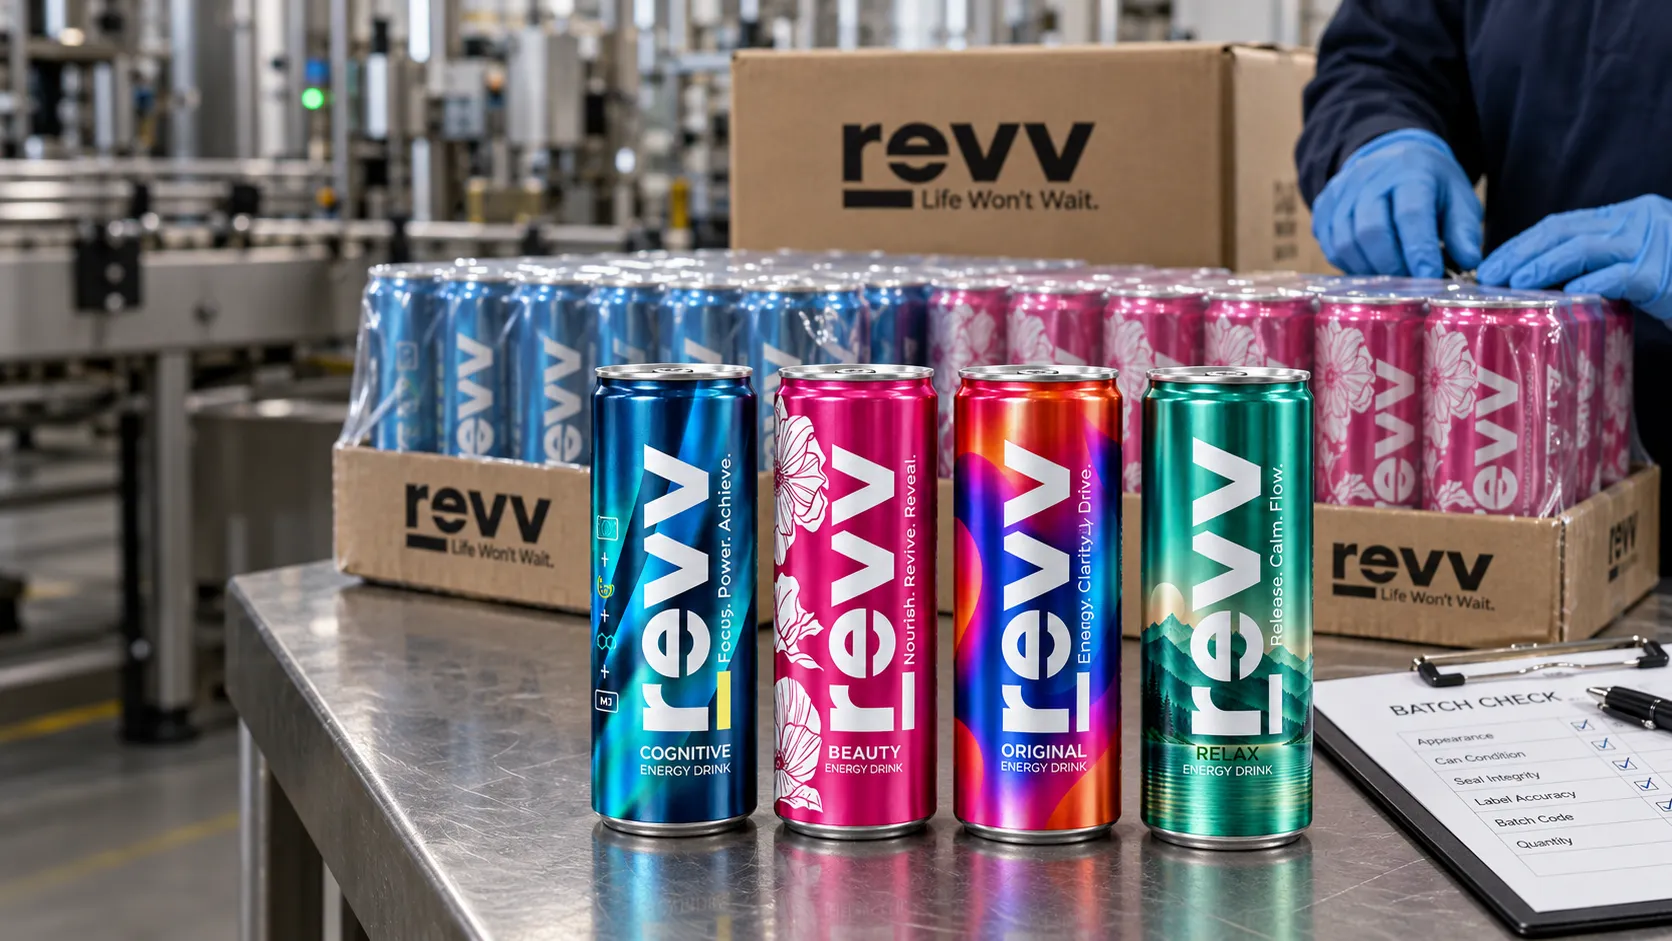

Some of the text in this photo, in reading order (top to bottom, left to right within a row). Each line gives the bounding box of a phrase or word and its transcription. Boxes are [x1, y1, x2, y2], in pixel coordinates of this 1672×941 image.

[842, 121, 1096, 185] revv
[922, 188, 1099, 210] Life Won't Wait.
[456, 332, 494, 455] evv
[543, 335, 583, 463] evv
[1373, 358, 1416, 508] evv
[1472, 365, 1519, 513] evv
[717, 453, 732, 532] Achieve.
[1077, 464, 1092, 513] Drive.
[405, 482, 552, 544] revv
[451, 538, 555, 568] Life Won't Wait.
[903, 454, 916, 665] Nourish. Revive. Reveal.
[1269, 463, 1283, 646] Release. Calm. Flow.
[1332, 542, 1494, 592] revv
[717, 536, 732, 599] Power.
[642, 443, 711, 732] revv
[829, 443, 896, 732] revv
[1001, 439, 1071, 733] revv
[1189, 438, 1264, 736] revv
[1381, 588, 1496, 612] Life Won't Wait.
[1389, 691, 1562, 717] BATCH CHECK
[640, 743, 731, 761] COGNITIVE
[828, 744, 901, 761] BEAUTY
[1001, 743, 1087, 759] ORIGINAL
[1196, 746, 1259, 761] RELAX
[1417, 732, 1495, 747] Appearance
[640, 762, 731, 777] ENERGY DRINK
[825, 762, 903, 774] ENERGY DRINK
[1001, 760, 1087, 773] ENERGY DRINK
[1183, 764, 1273, 777] ENERGY DRINK
[1434, 750, 1527, 766] Can Condition
[1453, 771, 1540, 786] Seal Integrity
[1474, 790, 1577, 806] Label Accuracy
[1494, 813, 1575, 828] Batch Code
[1516, 836, 1573, 850] Quantity
